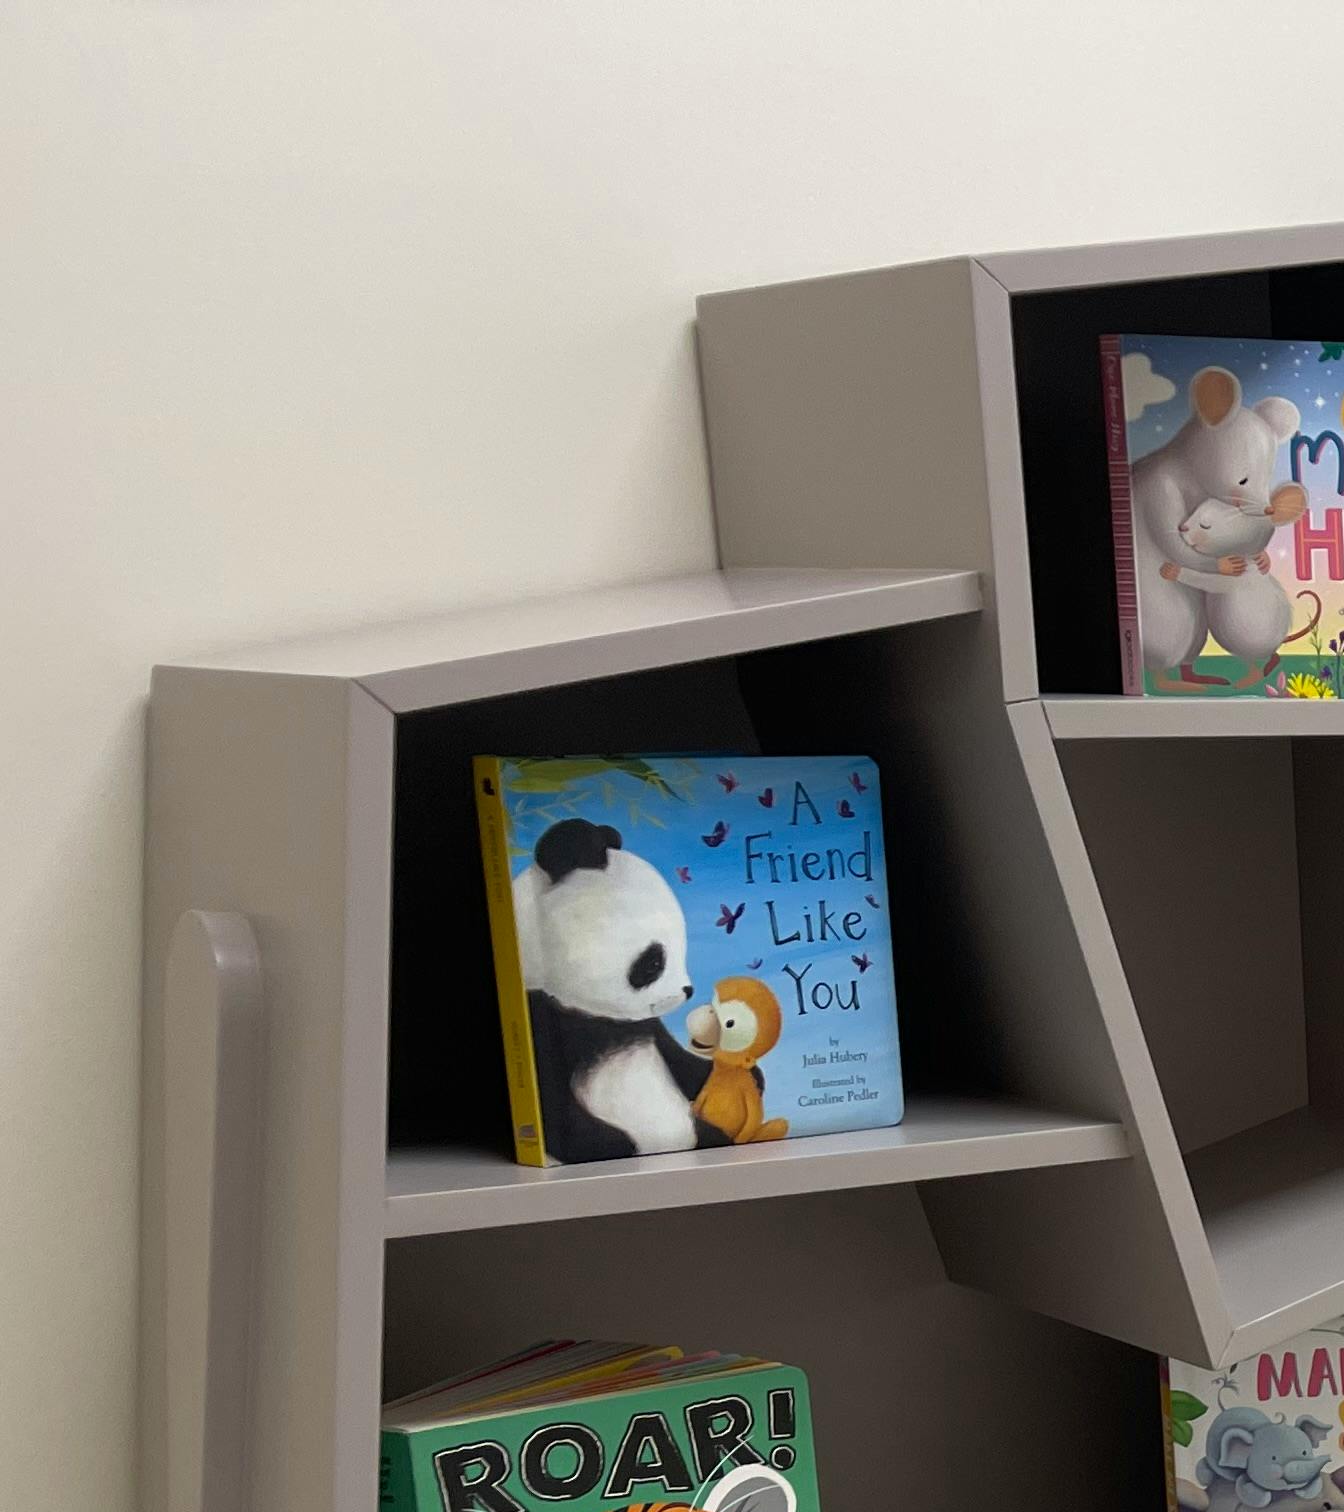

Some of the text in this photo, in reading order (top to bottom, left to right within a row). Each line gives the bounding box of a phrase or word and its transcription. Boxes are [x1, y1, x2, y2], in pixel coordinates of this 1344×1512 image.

[789, 781, 822, 825] A
[745, 831, 874, 884] Friend
[766, 900, 867, 945] Like
[782, 963, 860, 1015] You
[802, 1050, 868, 1069] Julia Hubery
[829, 1035, 839, 1047] by
[798, 1088, 879, 1107] Caroline Pedler
